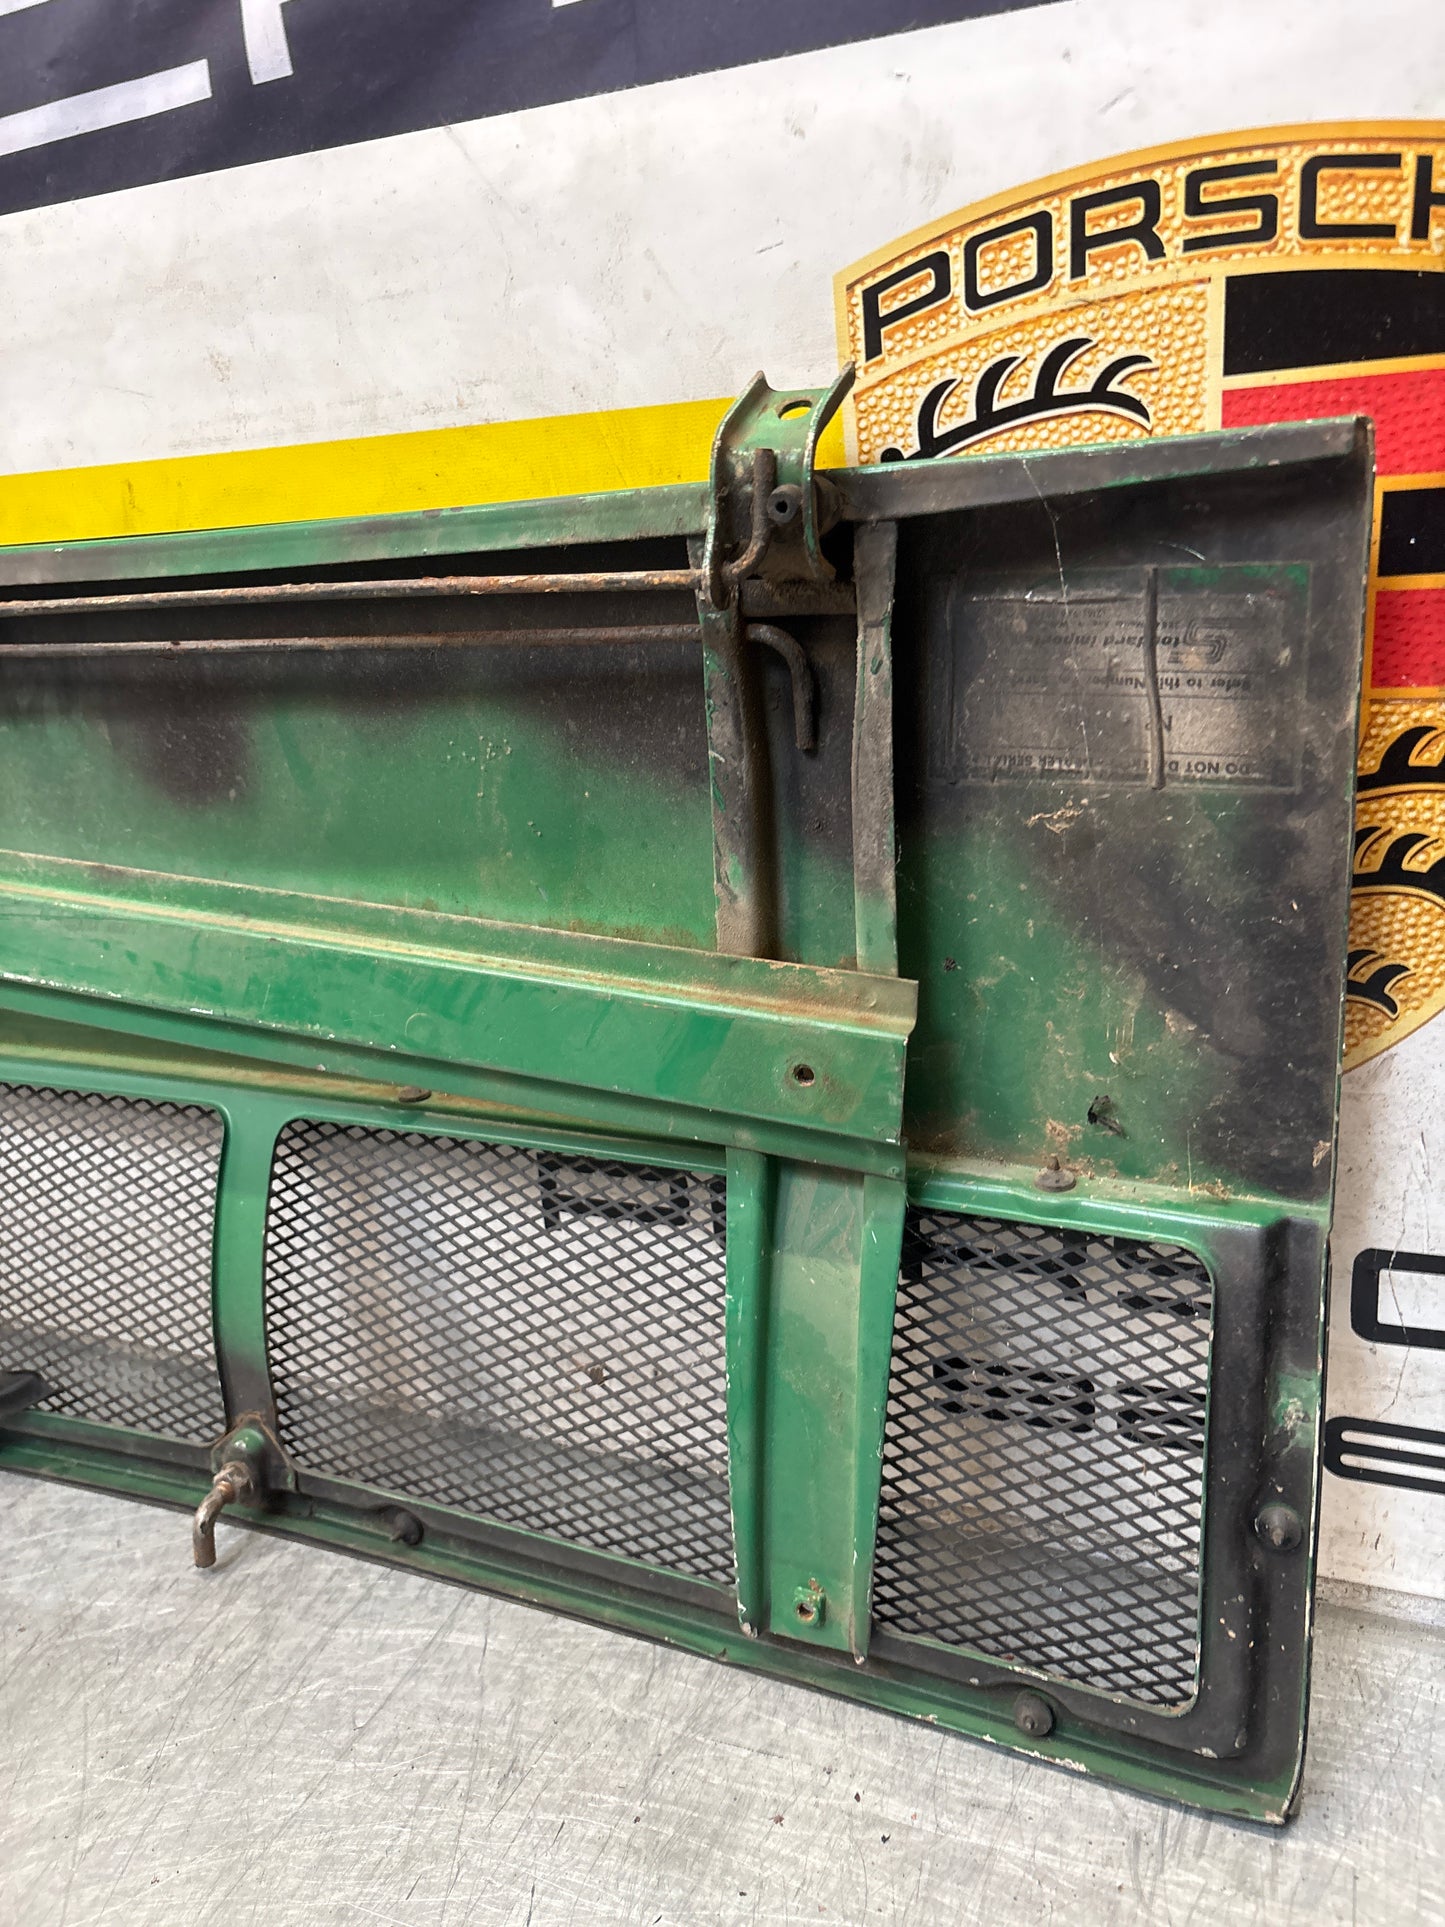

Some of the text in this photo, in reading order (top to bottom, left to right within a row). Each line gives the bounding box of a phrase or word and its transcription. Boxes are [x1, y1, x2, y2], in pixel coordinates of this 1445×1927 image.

[1158, 677, 1181, 690] thi
[1187, 679, 1202, 690] to
[1185, 762, 1220, 774] NOT
[1225, 763, 1251, 776] DO
